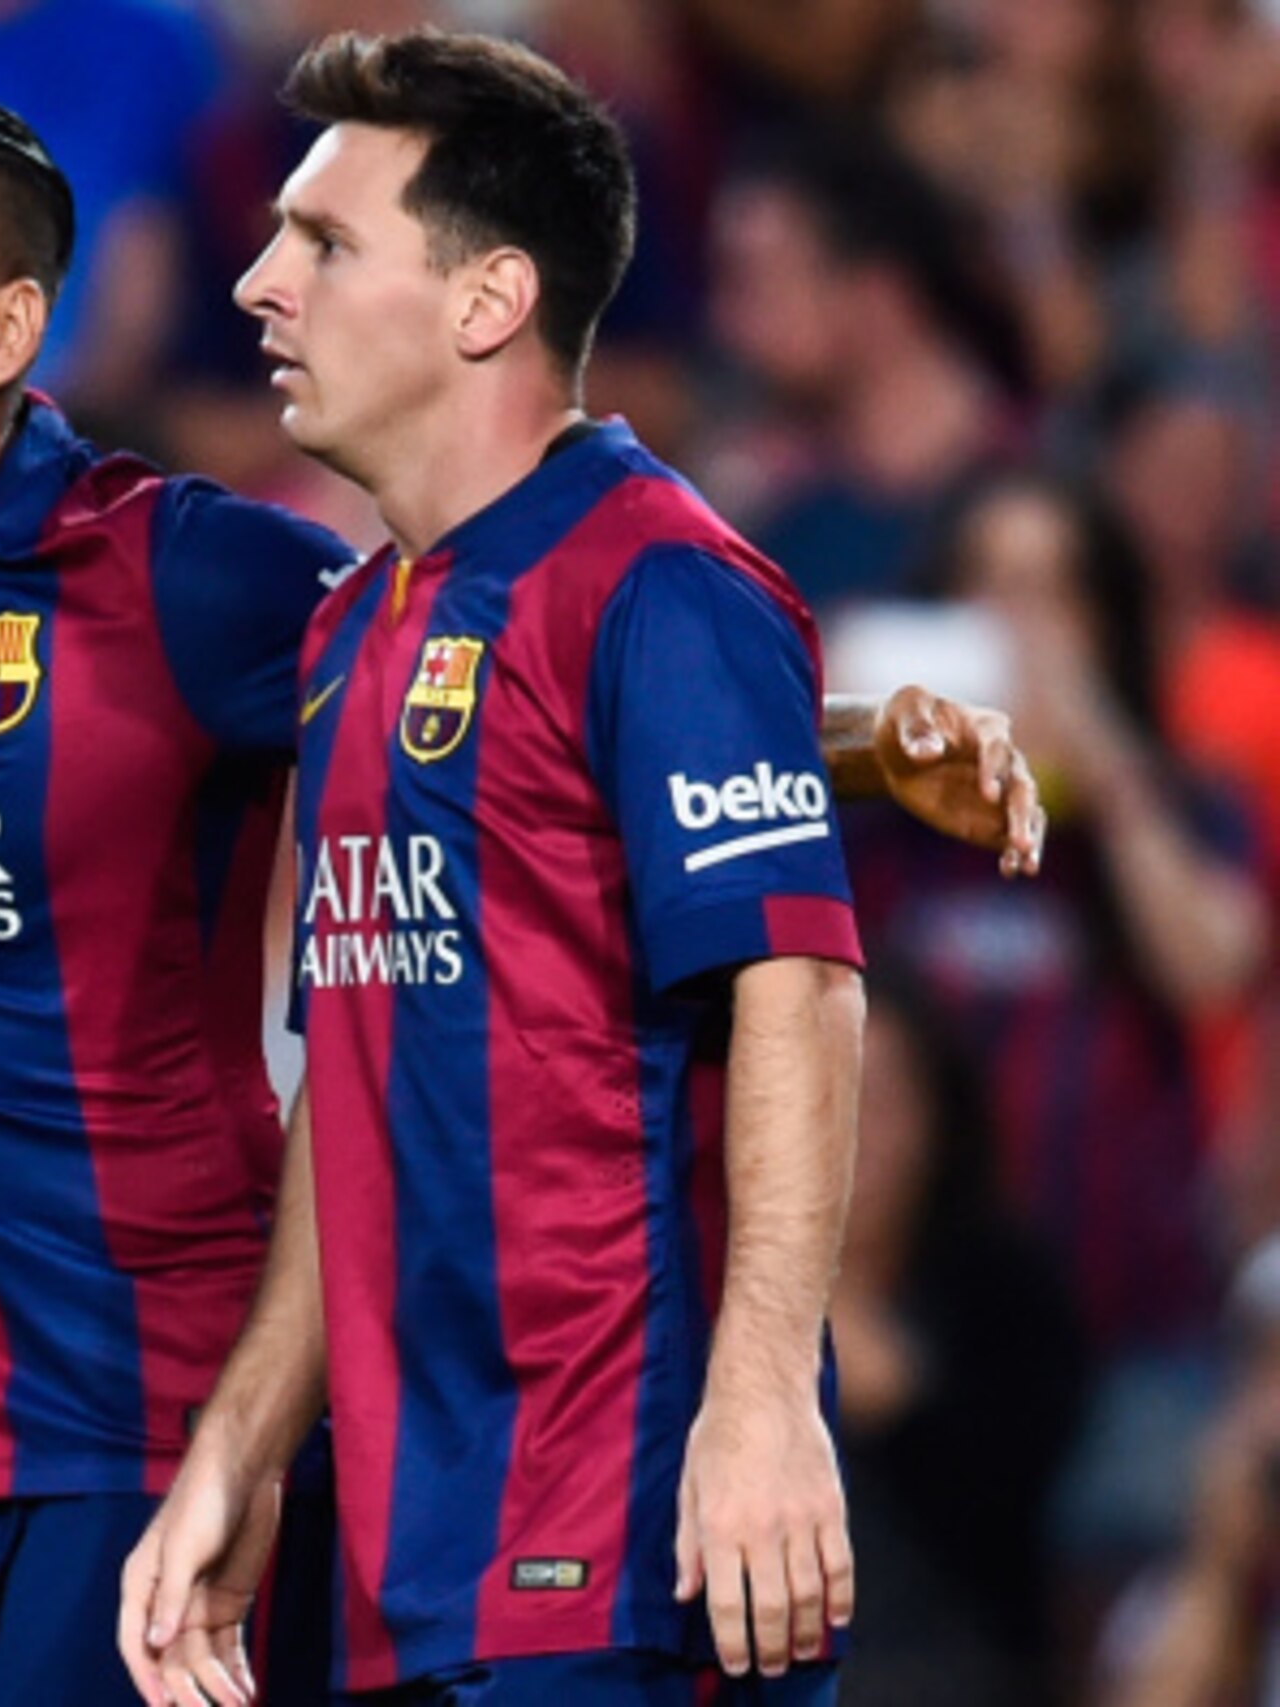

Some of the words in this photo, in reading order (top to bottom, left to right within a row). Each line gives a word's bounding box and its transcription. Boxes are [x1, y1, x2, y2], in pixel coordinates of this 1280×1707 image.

[668, 761, 828, 830] beko
[296, 834, 458, 924] ATAR
[298, 928, 463, 988] AIRWAYS
